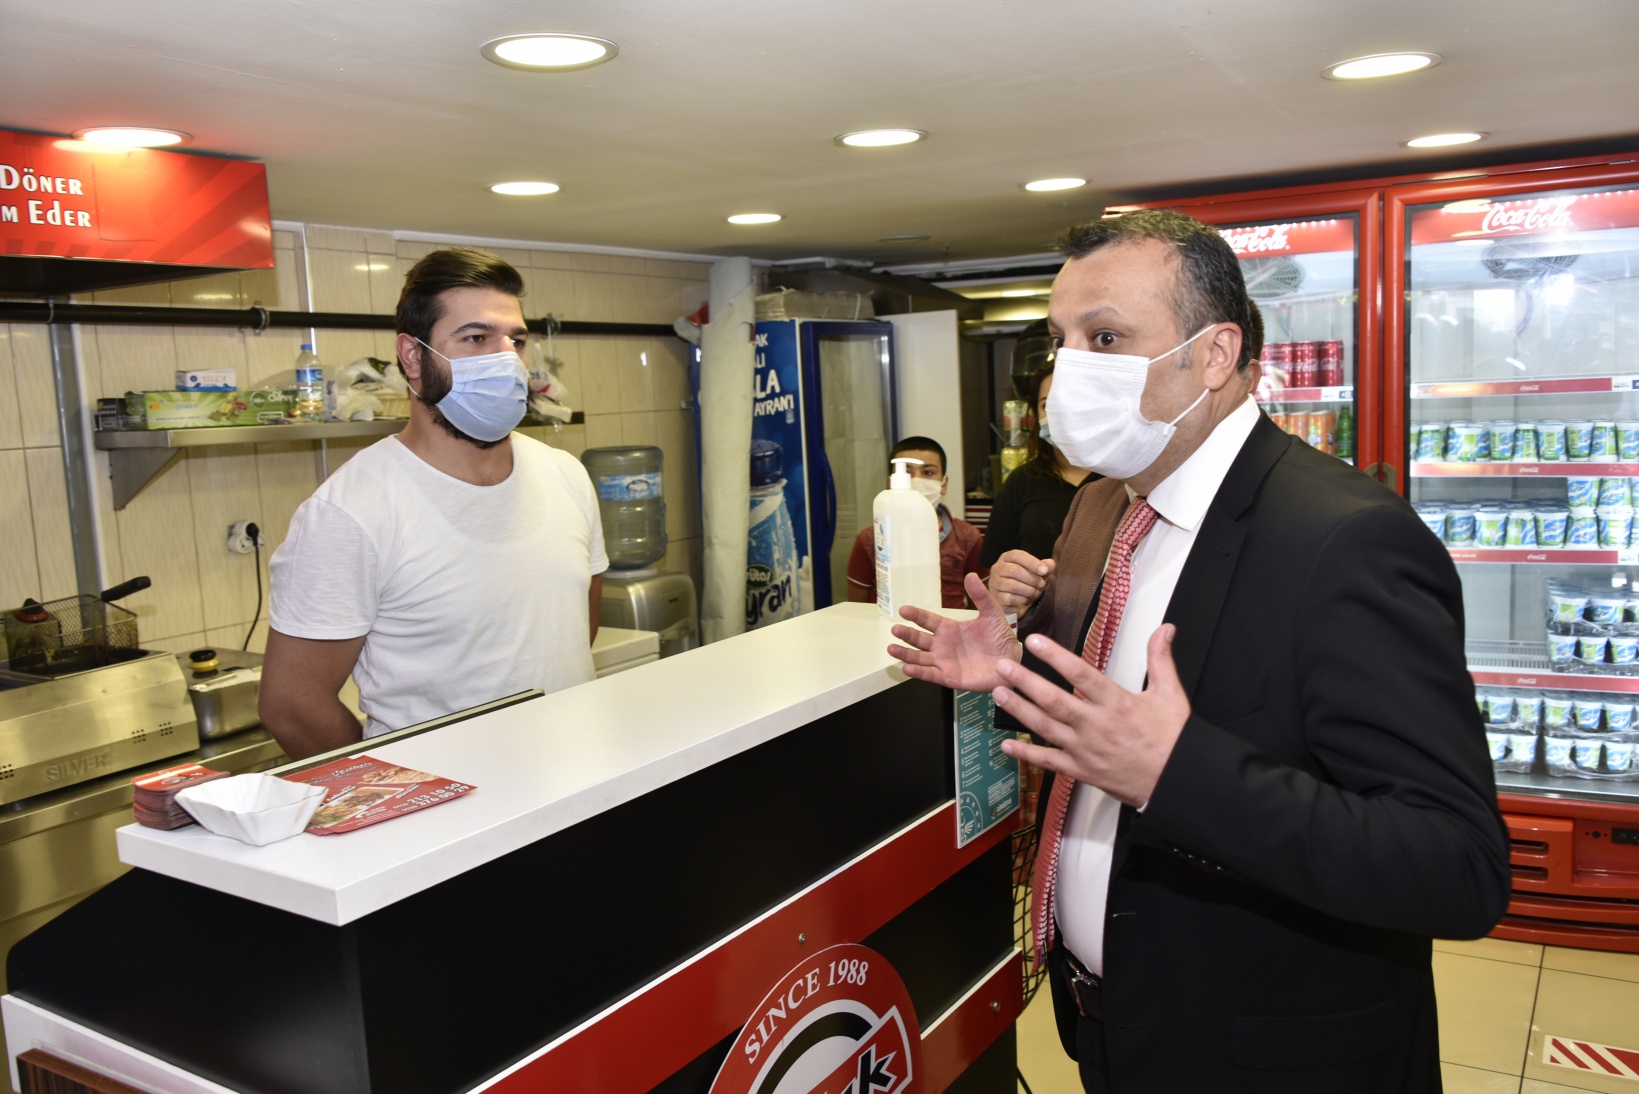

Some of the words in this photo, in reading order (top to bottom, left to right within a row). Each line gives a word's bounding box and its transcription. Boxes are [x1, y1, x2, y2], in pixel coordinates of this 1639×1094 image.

[753, 369, 781, 399] LA
[47, 752, 109, 781] SILVER
[744, 968, 820, 1065] SINCE
[827, 958, 869, 987] 1988
